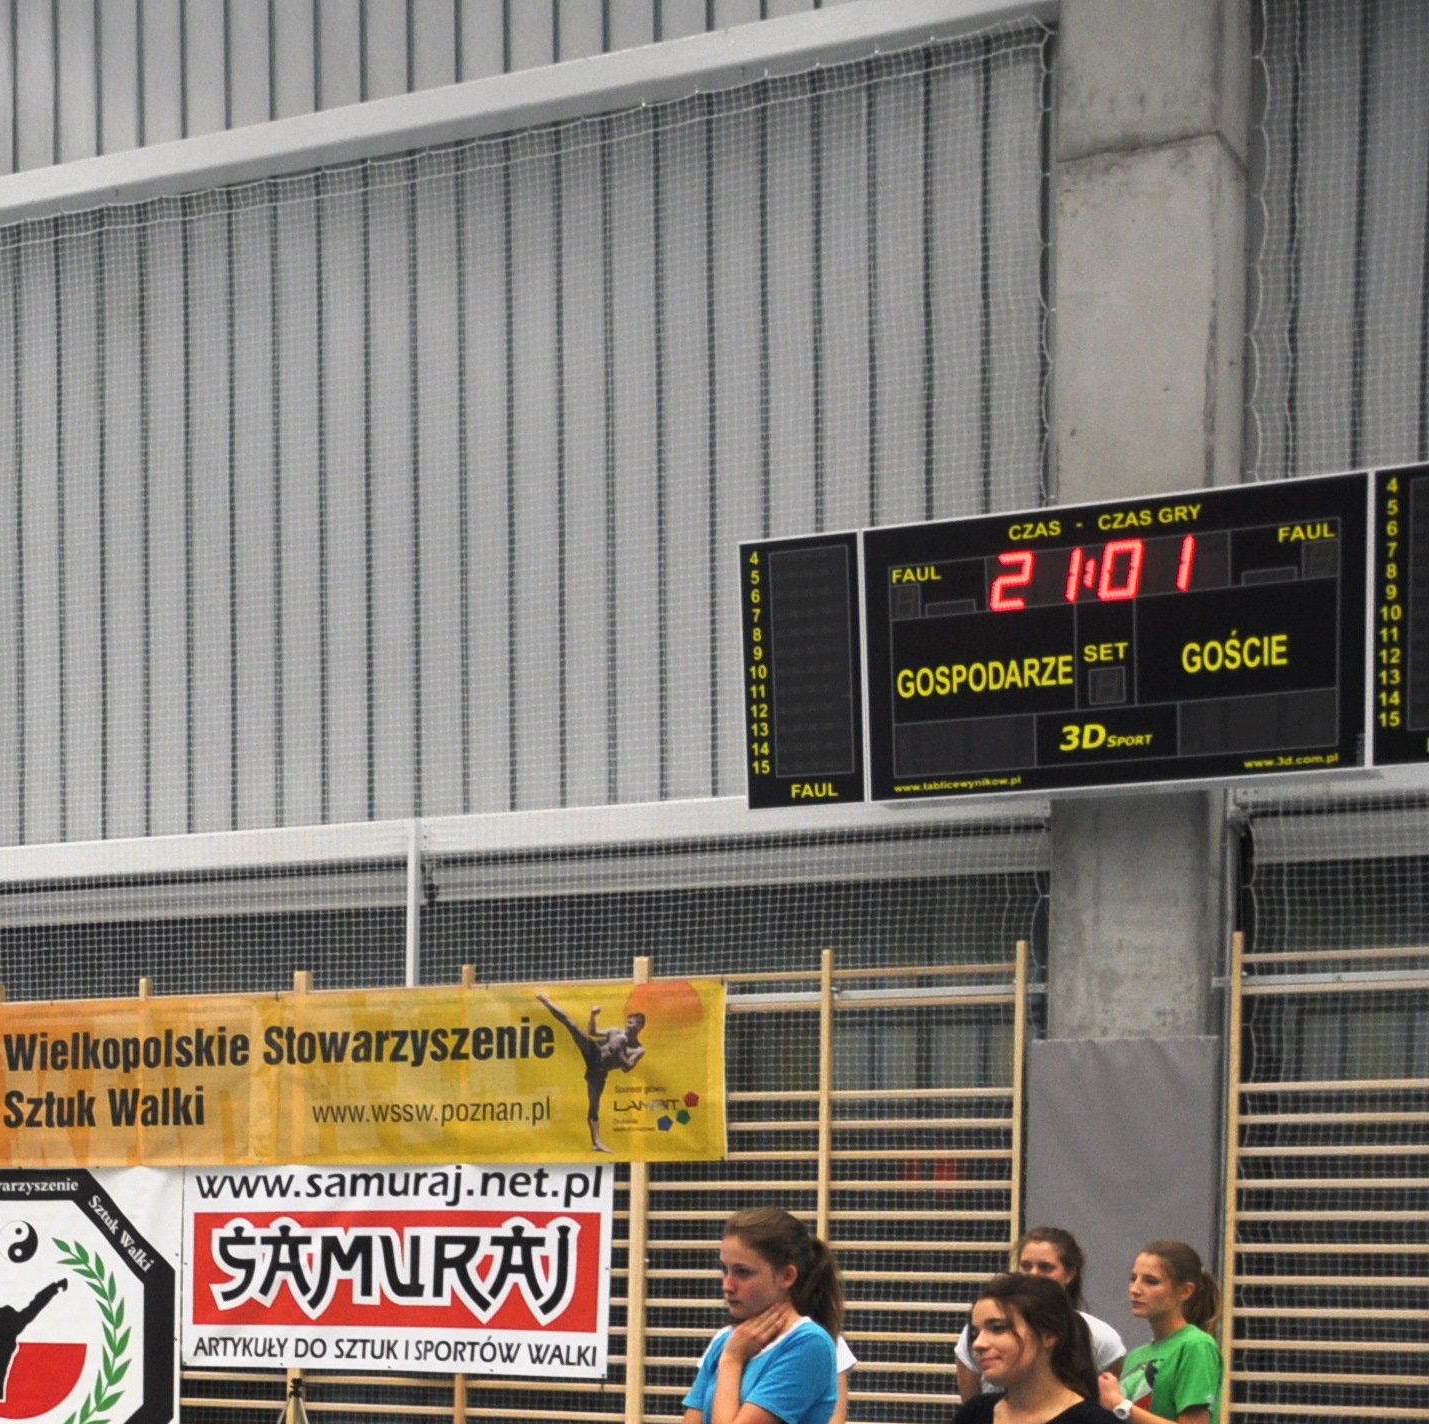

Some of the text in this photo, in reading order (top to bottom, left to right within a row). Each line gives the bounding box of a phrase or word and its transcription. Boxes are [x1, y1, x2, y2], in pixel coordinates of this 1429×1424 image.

[1386, 478, 1398, 492] 4
[1387, 500, 1398, 515] 5
[1009, 521, 1061, 541] CZAS
[1098, 510, 1152, 530] CZAS
[1158, 504, 1201, 523] GRY
[1386, 521, 1398, 536] 6
[1278, 523, 1335, 542] FAUL
[1386, 542, 1397, 557] 7
[750, 552, 759, 565] 4
[751, 571, 760, 584] 5
[892, 566, 941, 583] FAUL
[990, 534, 1194, 612] 21:01
[1386, 564, 1397, 578] 8
[751, 589, 761, 603] 6
[1385, 585, 1397, 599] 9
[752, 609, 761, 622] 7
[1380, 605, 1402, 621] 10
[752, 628, 762, 642] 8
[1380, 627, 1398, 641] 11
[753, 647, 762, 660] 9
[1084, 642, 1128, 663] SET
[1182, 630, 1288, 674] GOŚCIE
[1379, 649, 1400, 663] 12
[750, 665, 767, 679] 10
[897, 655, 1073, 698] GOSPODARZE
[1379, 670, 1400, 684] 13
[750, 685, 766, 698] 11
[1379, 691, 1400, 706] 14
[751, 704, 768, 718] 12
[1379, 712, 1400, 727] 15
[751, 723, 769, 736] 13
[1060, 724, 1106, 750] 3D
[752, 742, 769, 756] 14
[752, 761, 770, 774] 15
[1244, 753, 1339, 770] www.3d.com.pl
[791, 783, 838, 798] FAUL
[893, 775, 1021, 793] www.tablicewynikow.pl
[3, 1026, 250, 1073] Wielkopolskie
[263, 1018, 556, 1068] Stowarzyszenie
[3, 1086, 204, 1128] Sztuk Walki
[312, 1096, 551, 1127] www.wssw.poznan.pl
[195, 1165, 603, 1208] www.samuraj.net.pl
[88, 1195, 155, 1273] Sztuk Walki
[216, 1223, 575, 1319] SAMURAJ
[193, 1336, 597, 1367] ARTYKUŁY DO SZTUK I SPORTÓW WALKI
